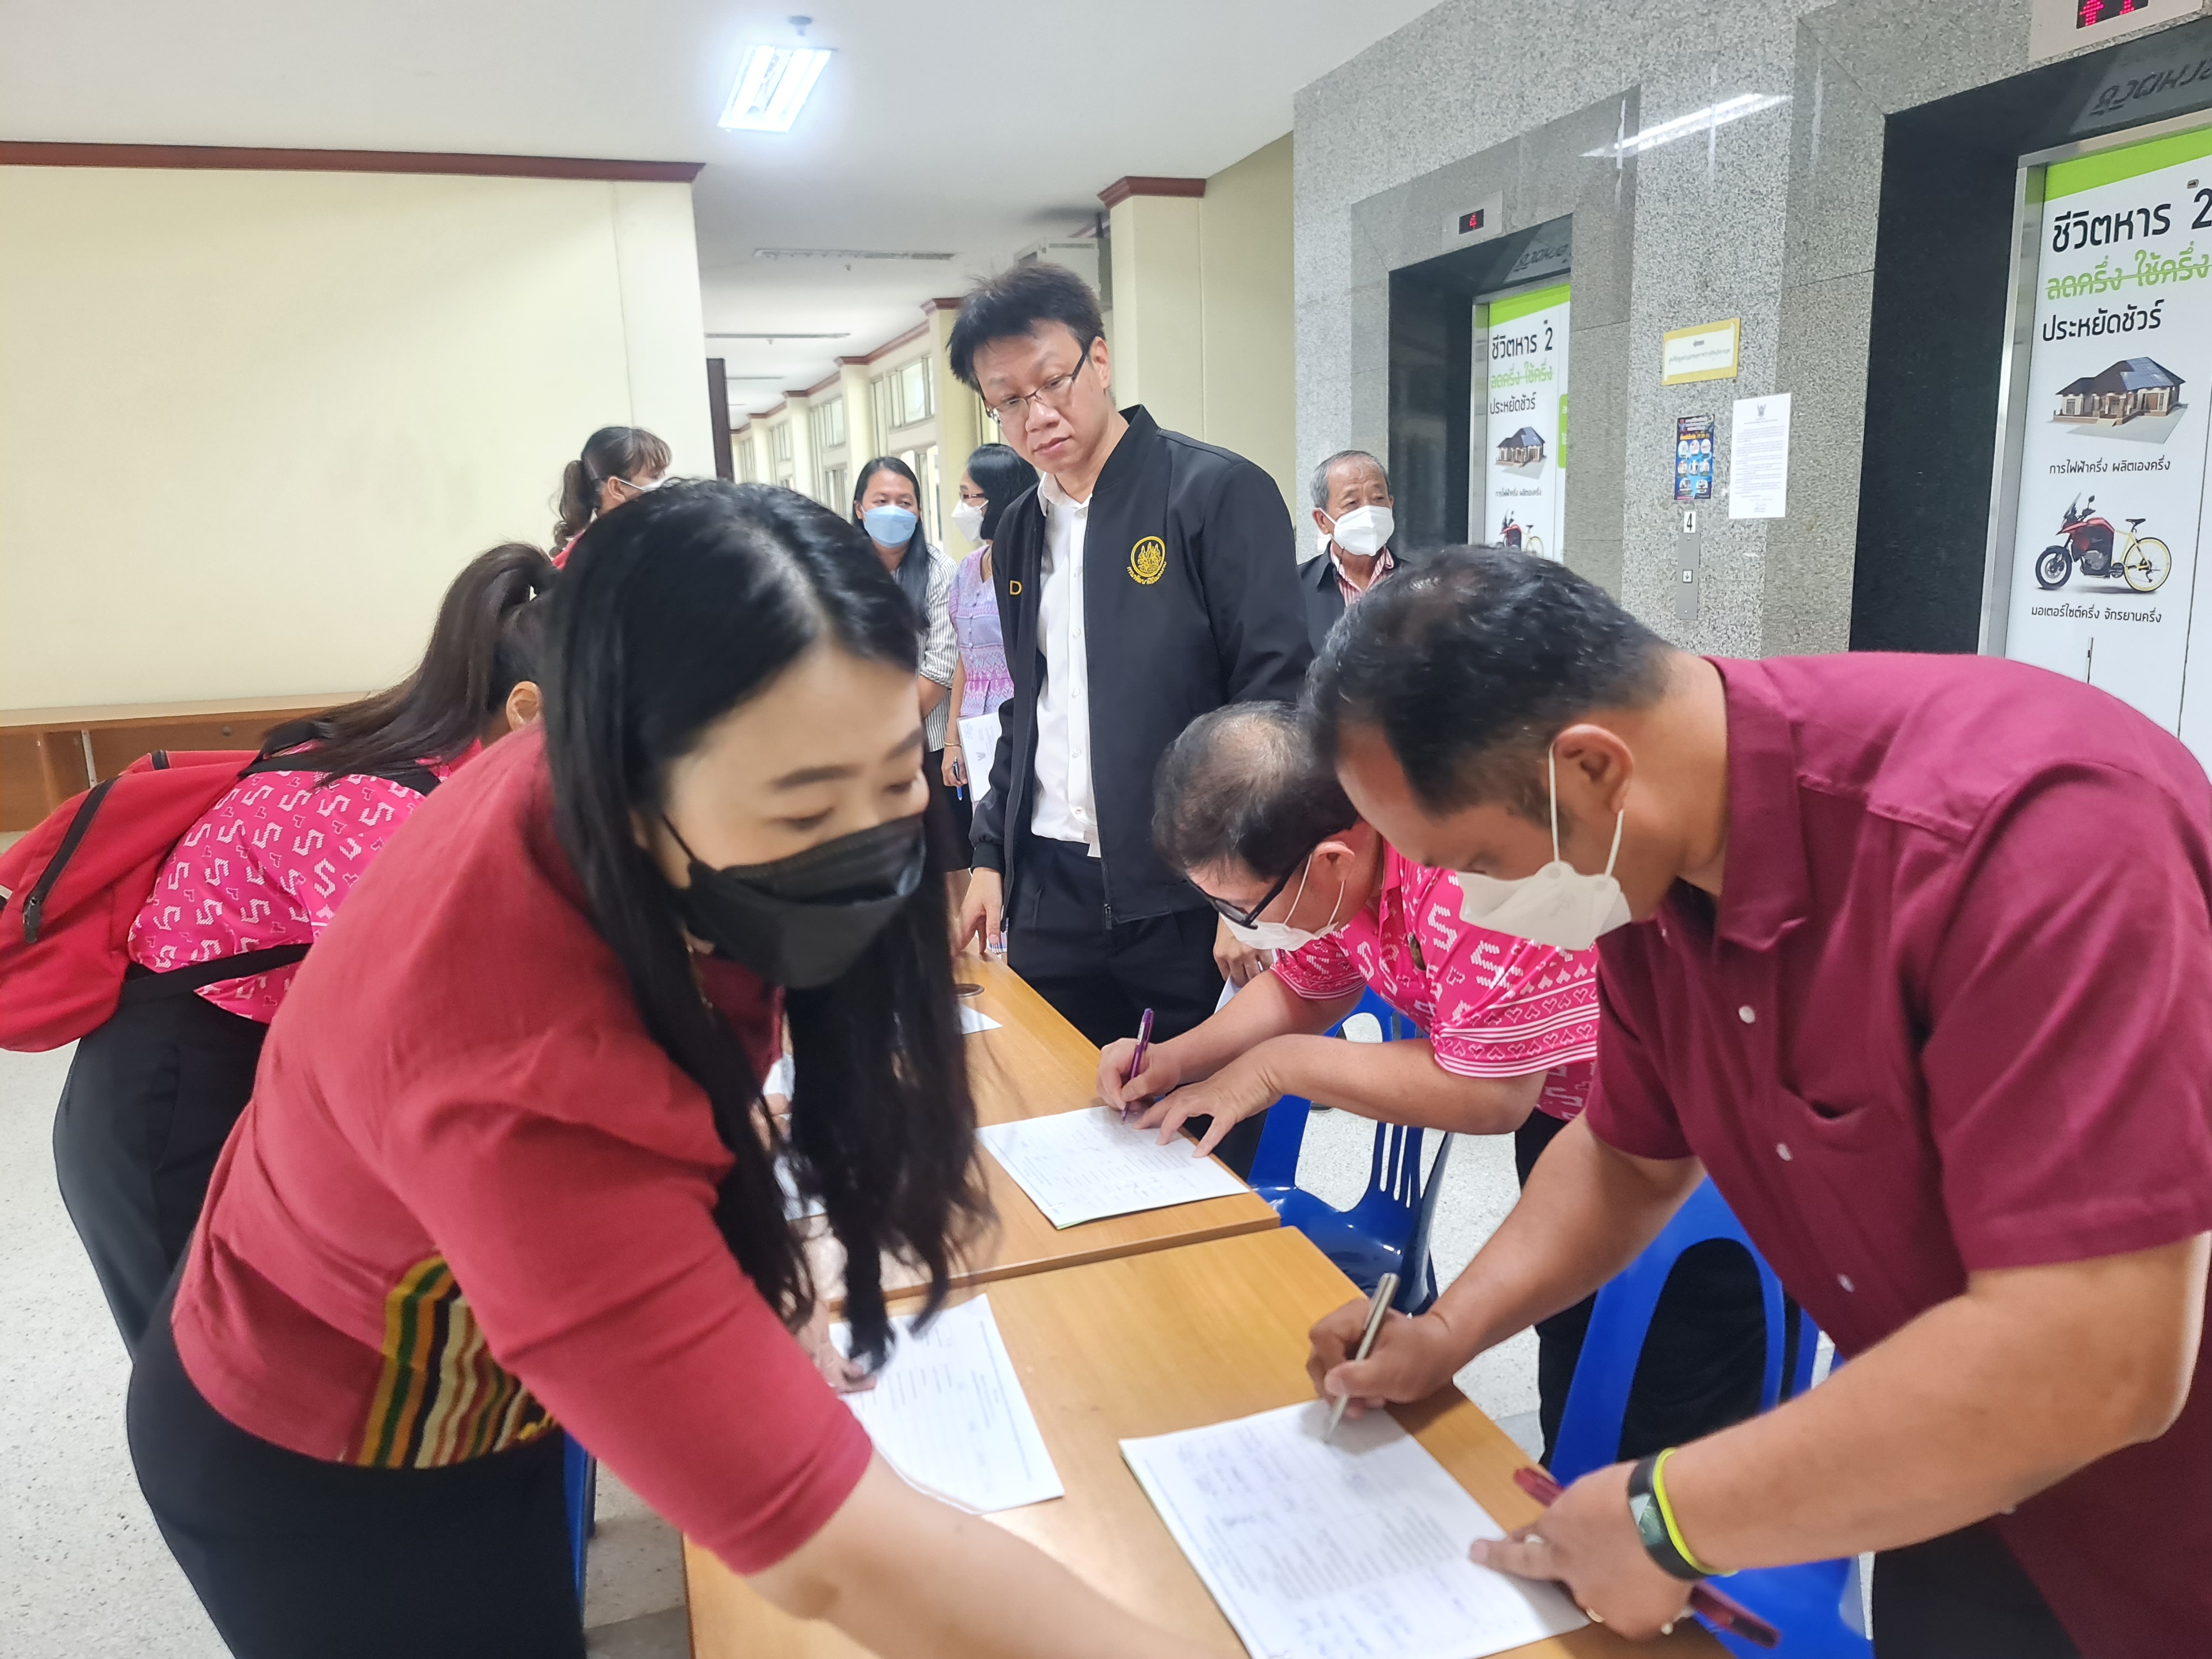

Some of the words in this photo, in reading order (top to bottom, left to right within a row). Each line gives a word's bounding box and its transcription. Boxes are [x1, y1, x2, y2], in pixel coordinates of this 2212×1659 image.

[1469, 212, 1477, 231] 4
[2052, 203, 2171, 252] ชีวิตหาร
[2191, 188, 2212, 229] 2
[2042, 299, 2164, 341] ประหยัดชัวร์
[1492, 335, 1537, 360] ชีวิตหาร
[1545, 327, 1553, 351] 2
[1490, 392, 1536, 414] ประหยัดชัวร์
[2049, 457, 2108, 474] การไฟฟ้าครึ่ง
[2112, 455, 2171, 472] ผลิตเองครึ่ง
[1686, 513, 1692, 531] 4
[1009, 580, 1022, 596] D
[2104, 607, 2162, 623] จักรยานครึ่ง
